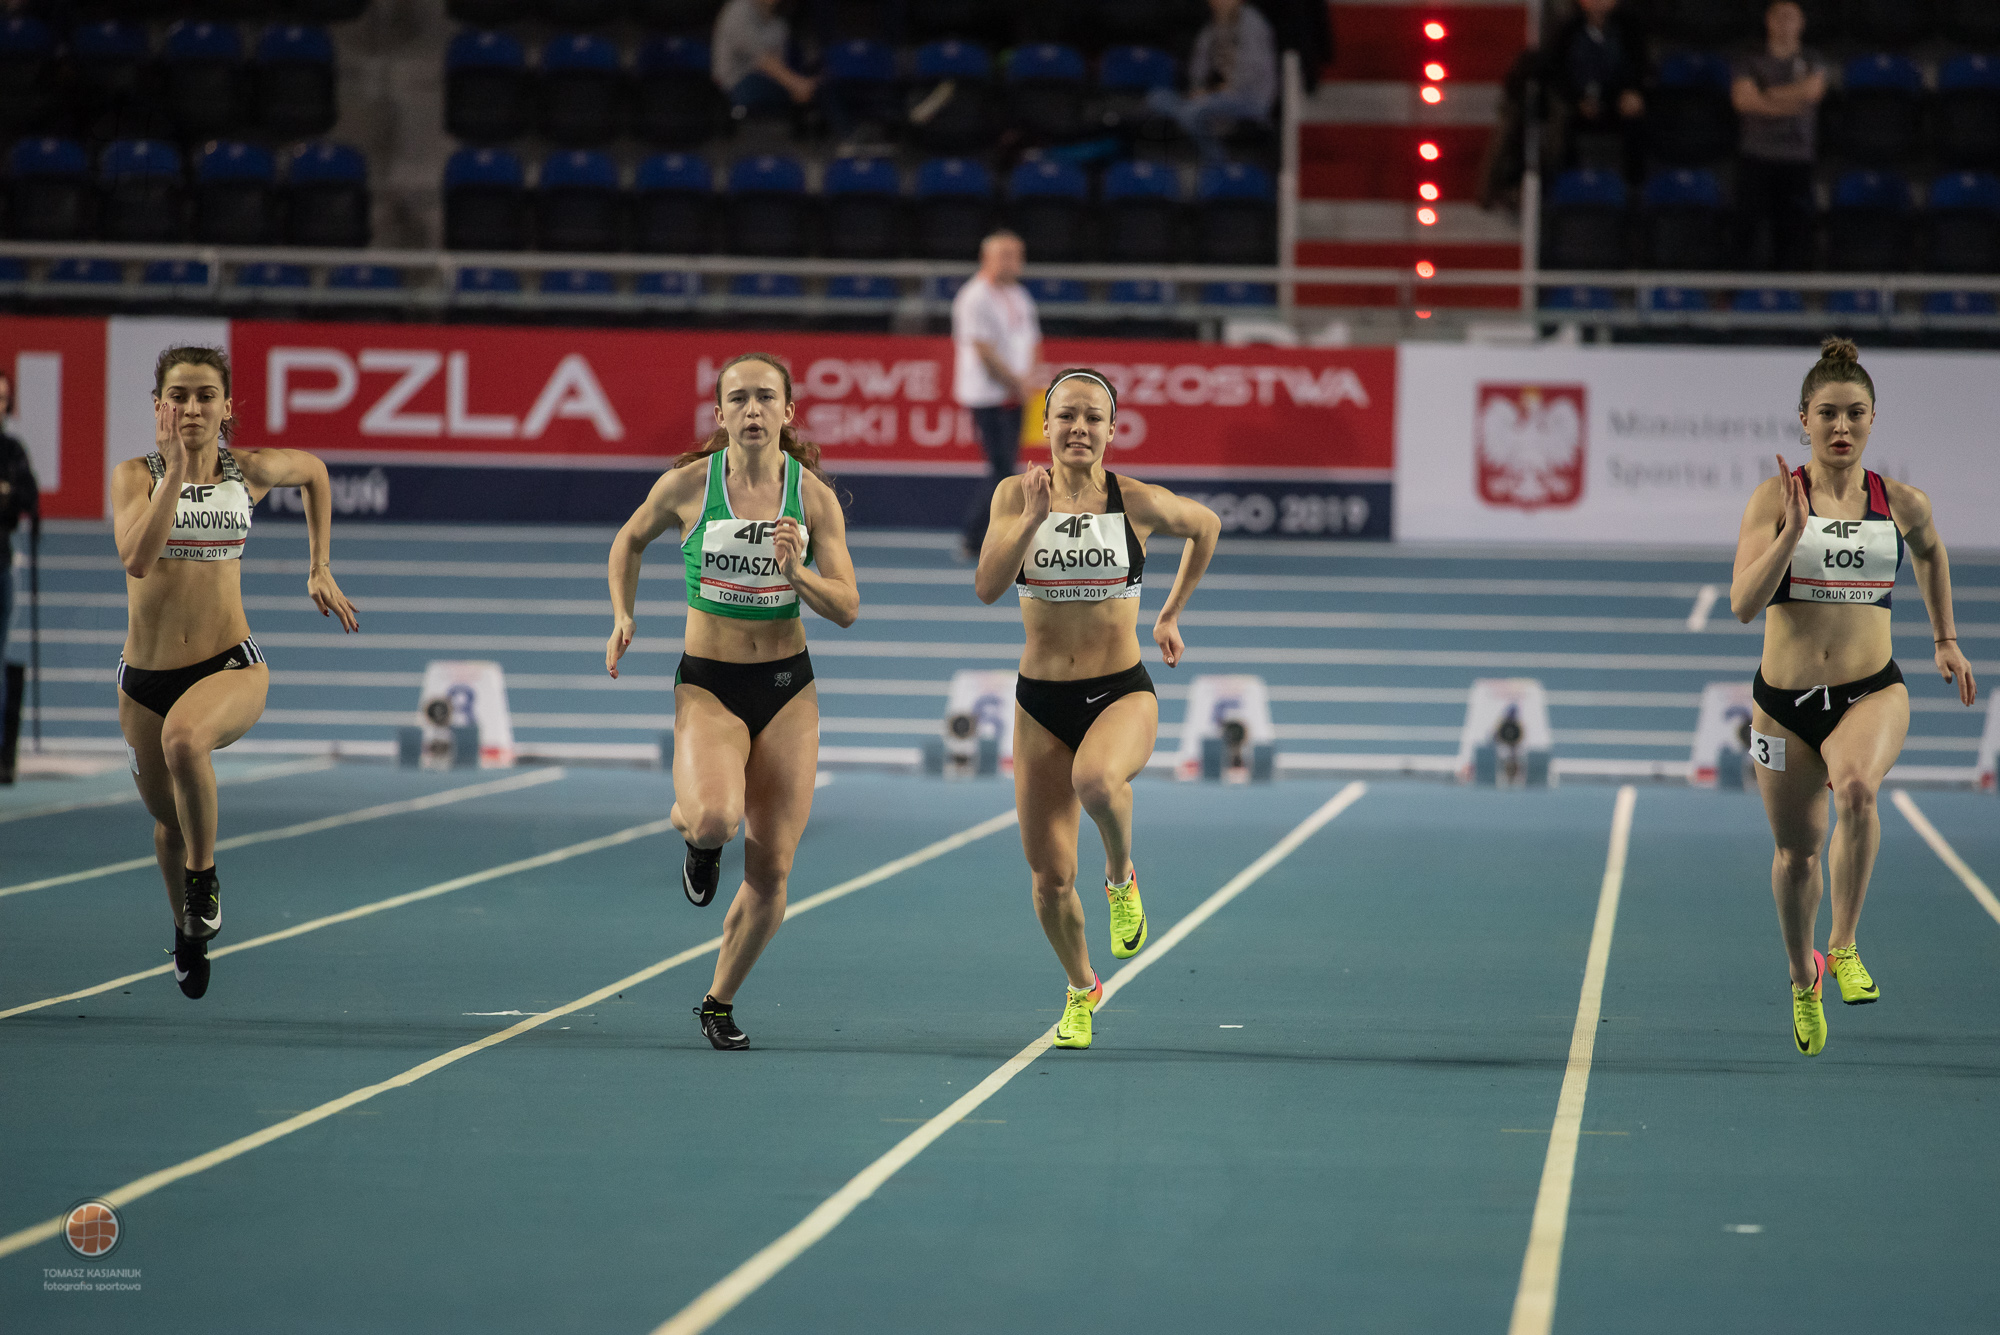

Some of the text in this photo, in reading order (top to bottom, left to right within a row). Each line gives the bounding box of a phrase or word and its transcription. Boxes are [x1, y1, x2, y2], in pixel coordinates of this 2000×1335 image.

[266, 347, 625, 440] PZLA
[179, 485, 215, 502] 4F
[172, 511, 247, 529] LANOWSKA
[1055, 514, 1093, 538] 4F
[734, 522, 777, 544] 4F
[1822, 521, 1862, 538] 4F
[169, 546, 227, 558] TORUŃ 2019
[1034, 548, 1118, 572] GĄSIOR
[1823, 546, 1865, 569] ŁOŚ
[719, 591, 780, 605] TORUŃ 2019
[1045, 586, 1108, 598] TORUŃ 2019
[1811, 588, 1874, 600] TORUŃ 2019
[1757, 738, 1770, 764] 3
